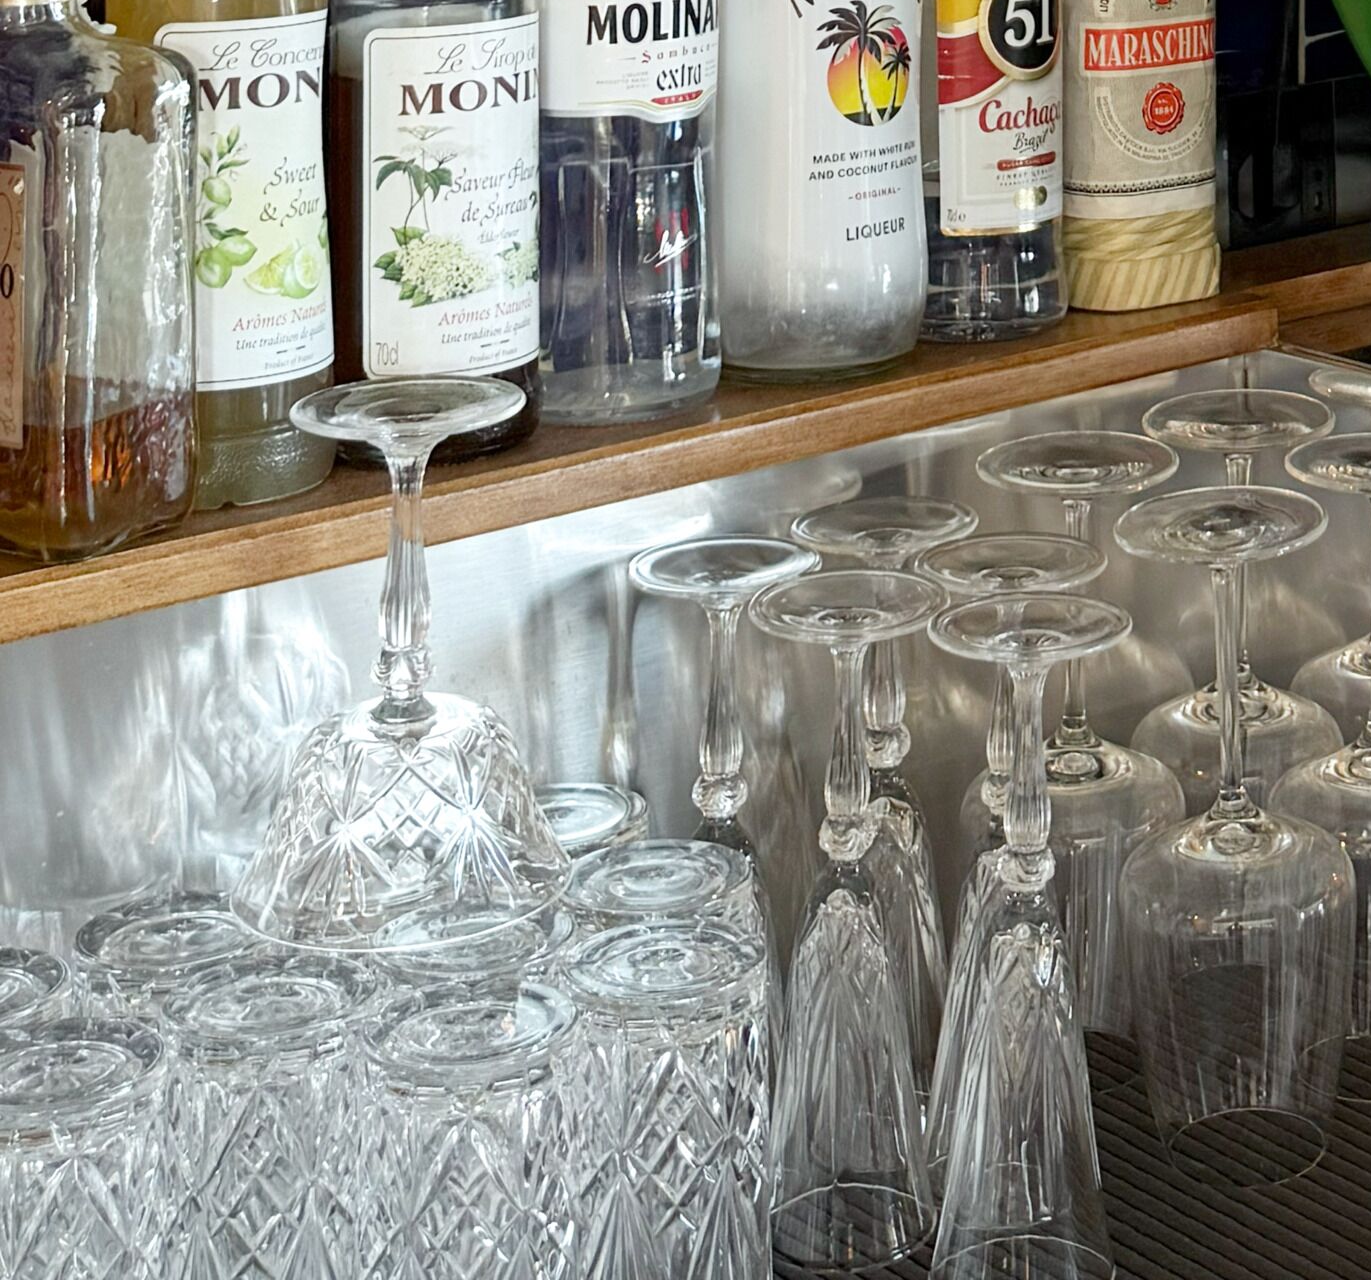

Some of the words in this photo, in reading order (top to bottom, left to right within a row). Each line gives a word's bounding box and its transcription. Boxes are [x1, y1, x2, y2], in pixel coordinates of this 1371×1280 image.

[198, 41, 241, 72] Le
[424, 42, 465, 75] Le
[472, 38, 525, 72] Sirop
[198, 66, 321, 112] MON
[656, 63, 702, 91] extra
[813, 152, 846, 165] MADE
[849, 148, 877, 161] WITH
[878, 143, 903, 157] WHITE
[265, 156, 318, 198] Sweet
[443, 167, 506, 201] Saveur
[809, 168, 835, 181] AND
[837, 162, 889, 178] COCONUT
[259, 202, 278, 222] &
[281, 188, 321, 228] Sour
[461, 201, 480, 224] de
[846, 217, 905, 242] LIQUEUR
[233, 312, 288, 333] Arômes
[438, 308, 491, 326] Arômes
